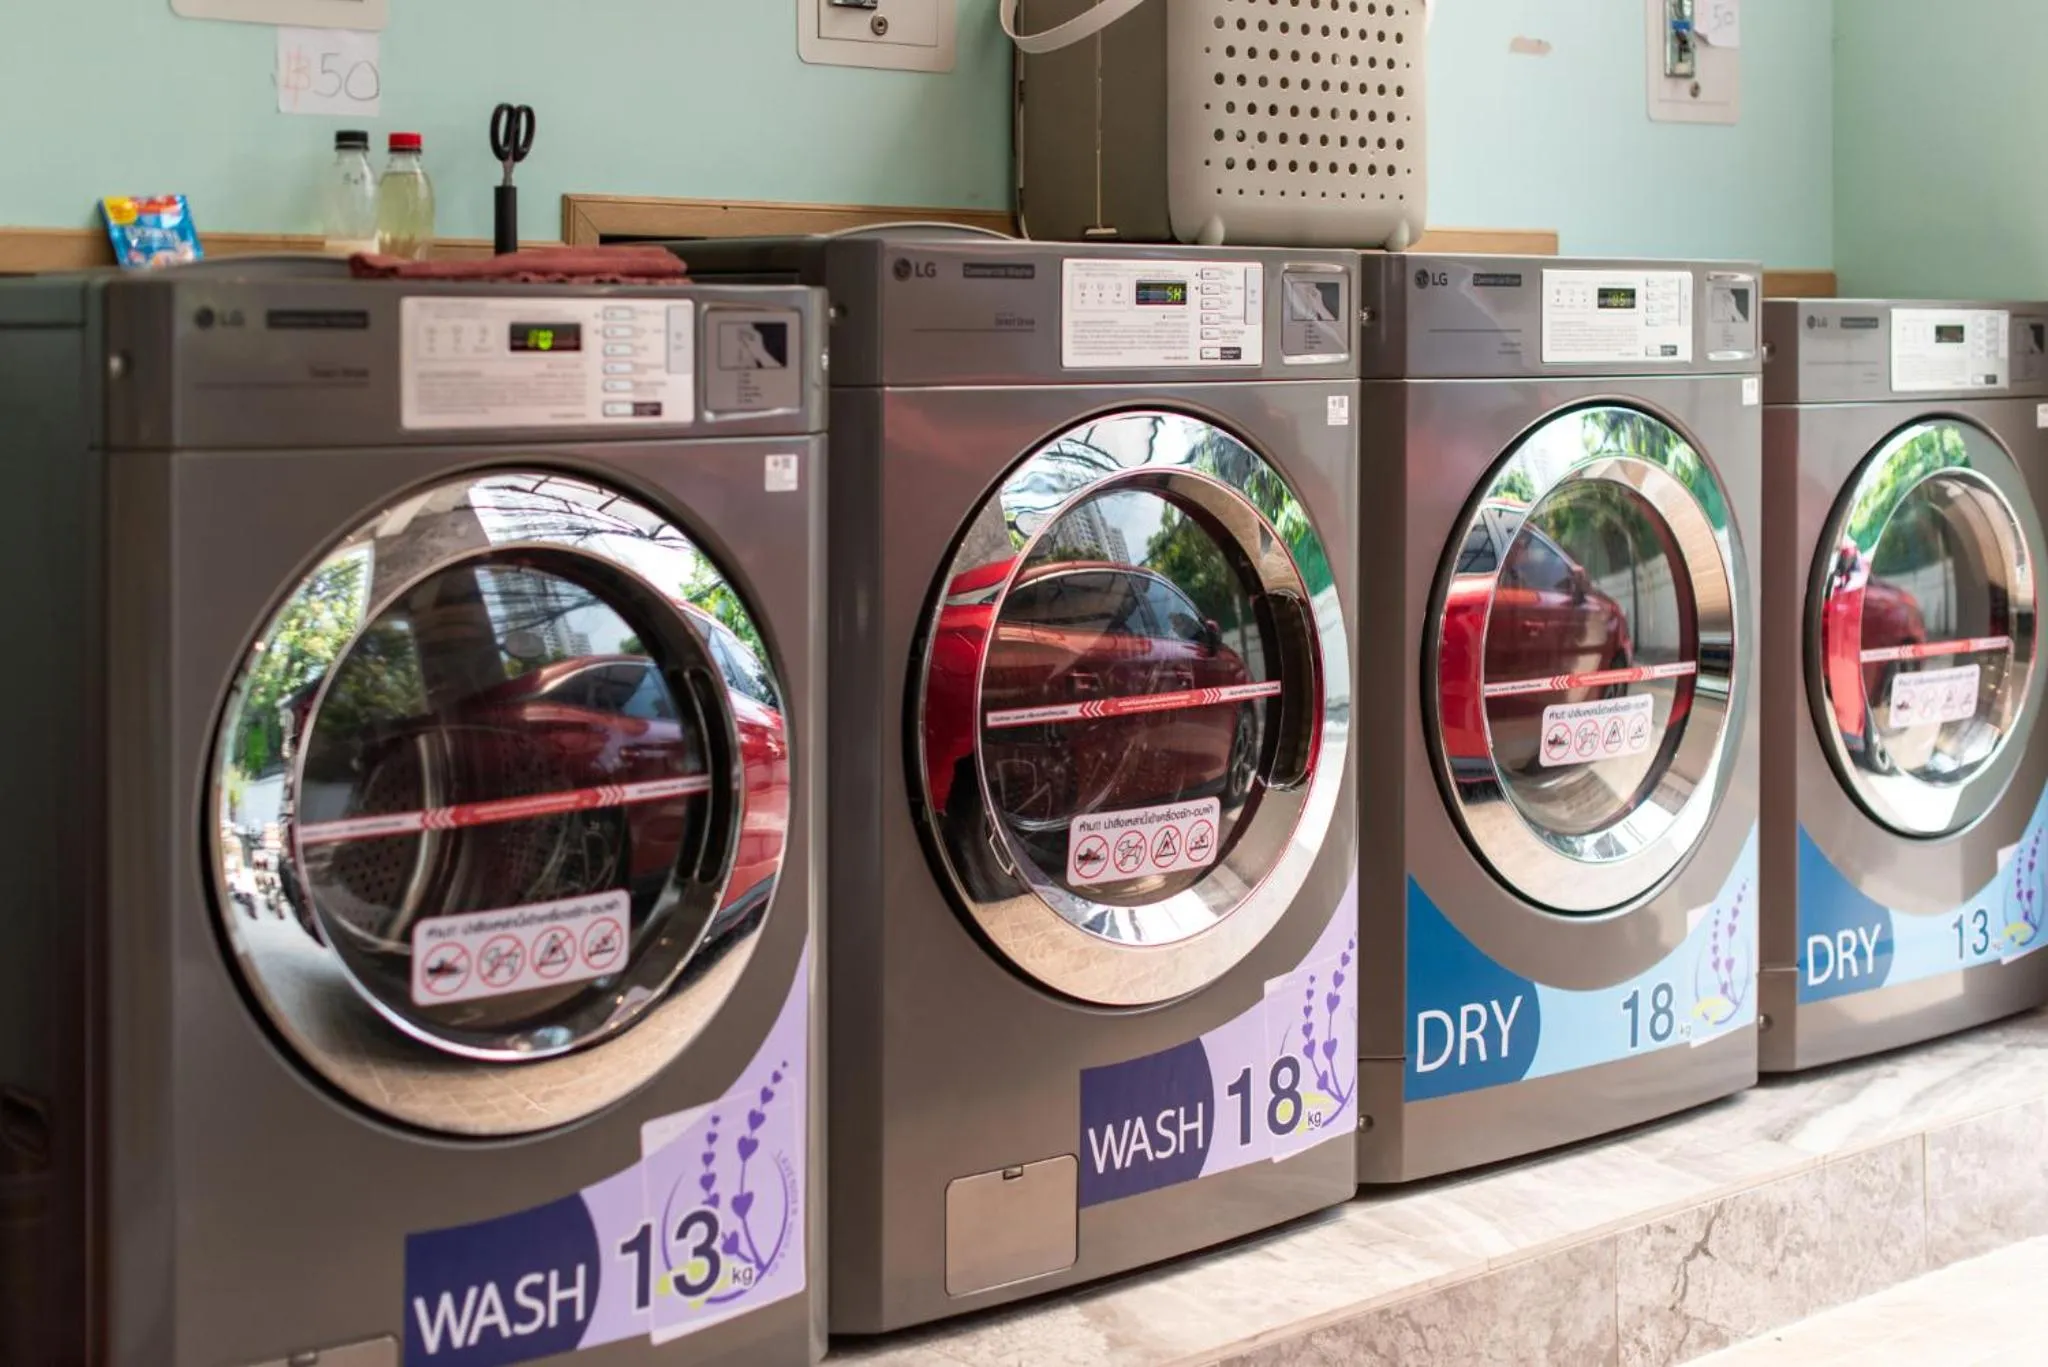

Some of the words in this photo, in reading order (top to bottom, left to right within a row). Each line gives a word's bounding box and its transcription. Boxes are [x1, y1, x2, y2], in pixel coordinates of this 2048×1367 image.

[915, 261, 937, 278] LG
[1431, 271, 1448, 286] LG
[1807, 923, 1881, 986] DRY
[1952, 909, 1990, 960] 13
[1416, 995, 1523, 1073] DRY
[1621, 982, 1675, 1048] 18
[1227, 1055, 1303, 1147] 18
[1307, 1110, 1322, 1128] kg
[1088, 1102, 1204, 1175] WASH
[620, 1210, 721, 1310] 13
[732, 1264, 754, 1286] kg
[413, 1263, 586, 1355] WASH
